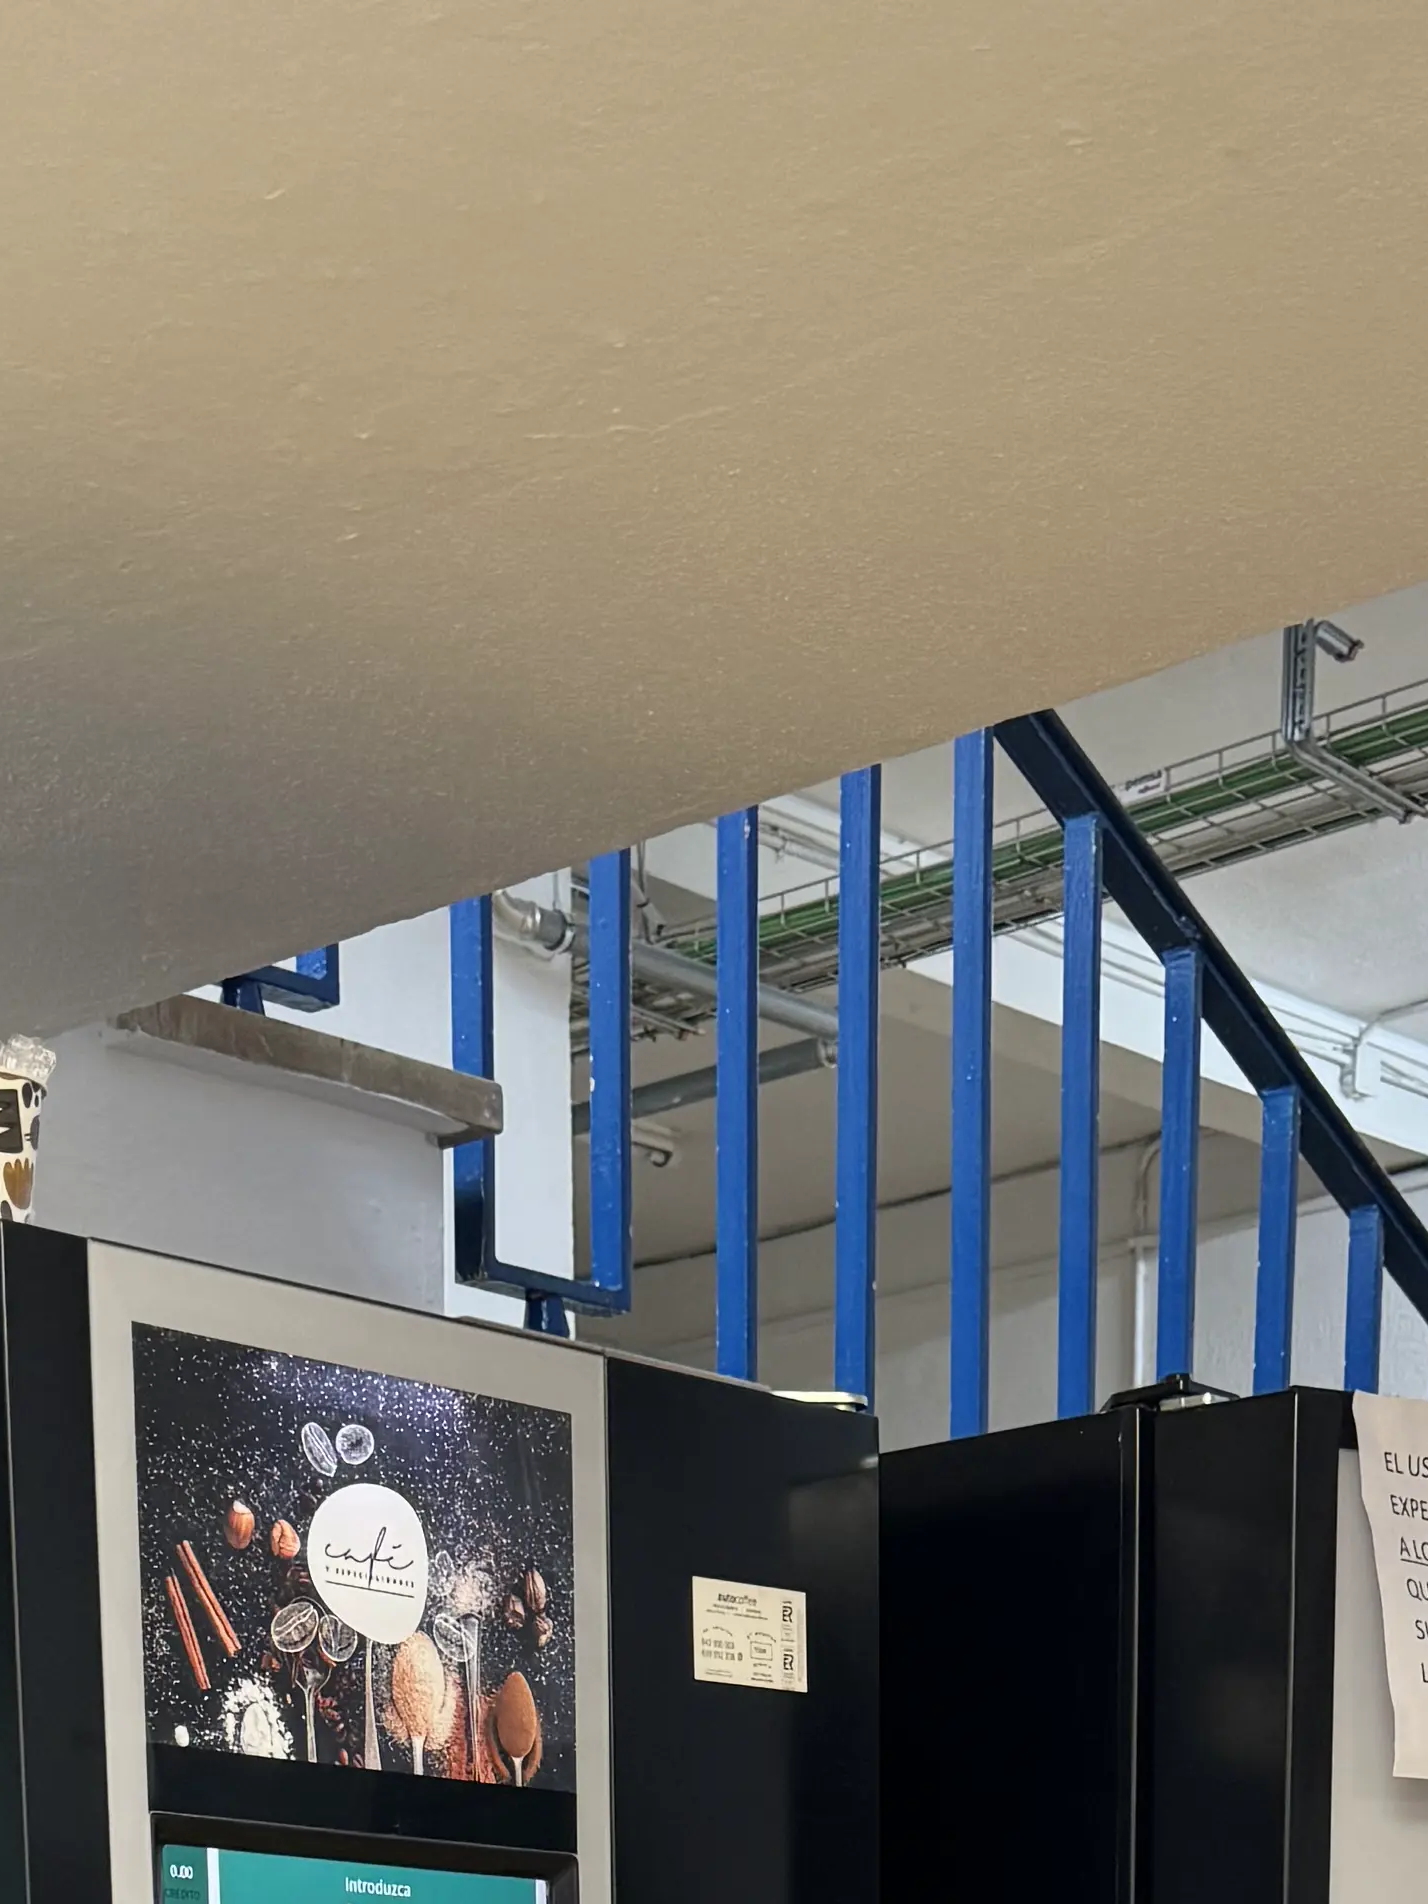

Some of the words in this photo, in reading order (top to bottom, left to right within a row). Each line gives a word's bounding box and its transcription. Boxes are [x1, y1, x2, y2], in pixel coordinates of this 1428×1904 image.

[1383, 1451, 1404, 1475] EL
[1399, 1536, 1412, 1557] A
[345, 1876, 412, 1898] Introduzca
